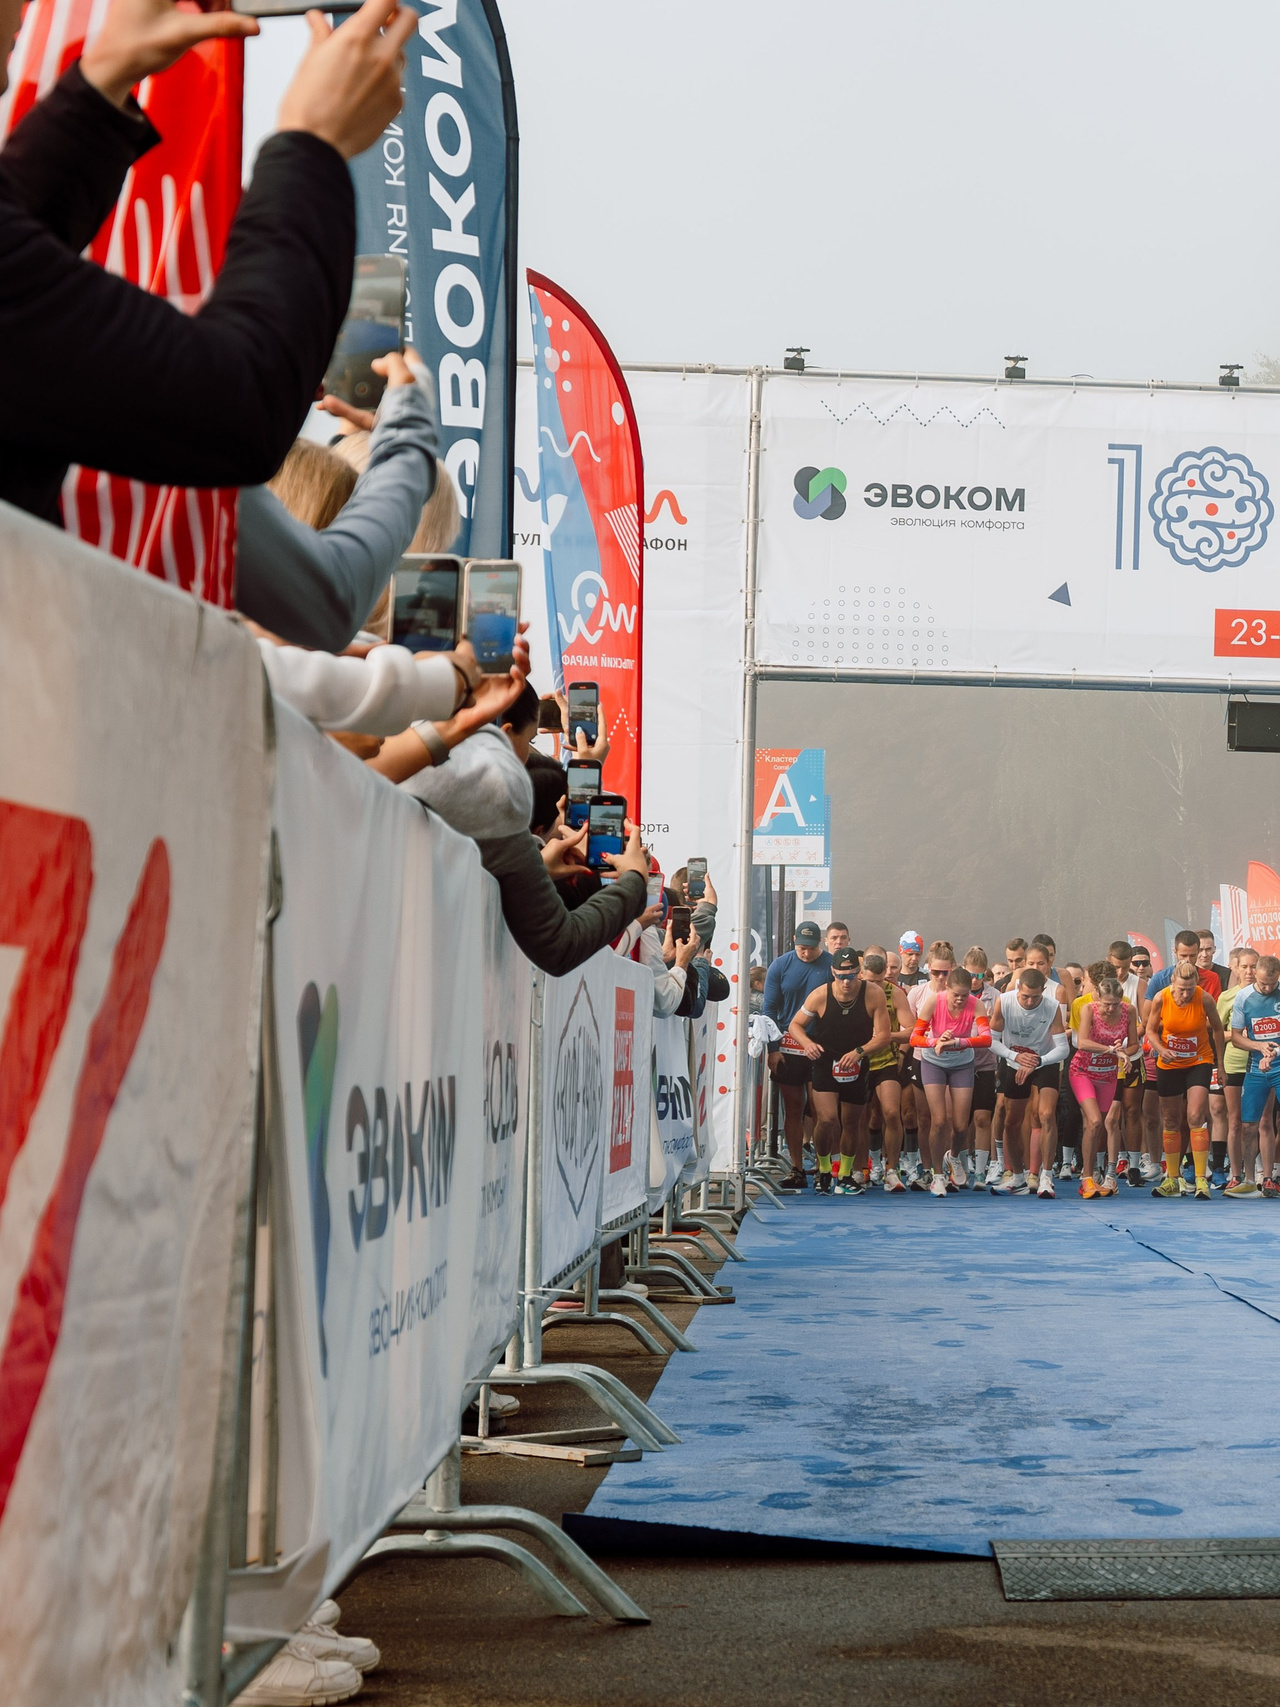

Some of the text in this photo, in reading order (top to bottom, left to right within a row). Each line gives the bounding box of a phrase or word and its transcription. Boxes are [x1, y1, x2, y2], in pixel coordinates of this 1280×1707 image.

[863, 482, 1026, 512] ЭВОКОМ
[890, 517, 1025, 532] эволюция комфорта
[641, 537, 687, 551] АФОН
[765, 755, 798, 765] Кластер
[1259, 1022, 1277, 1031] 2003
[1173, 1042, 1190, 1051] 2263
